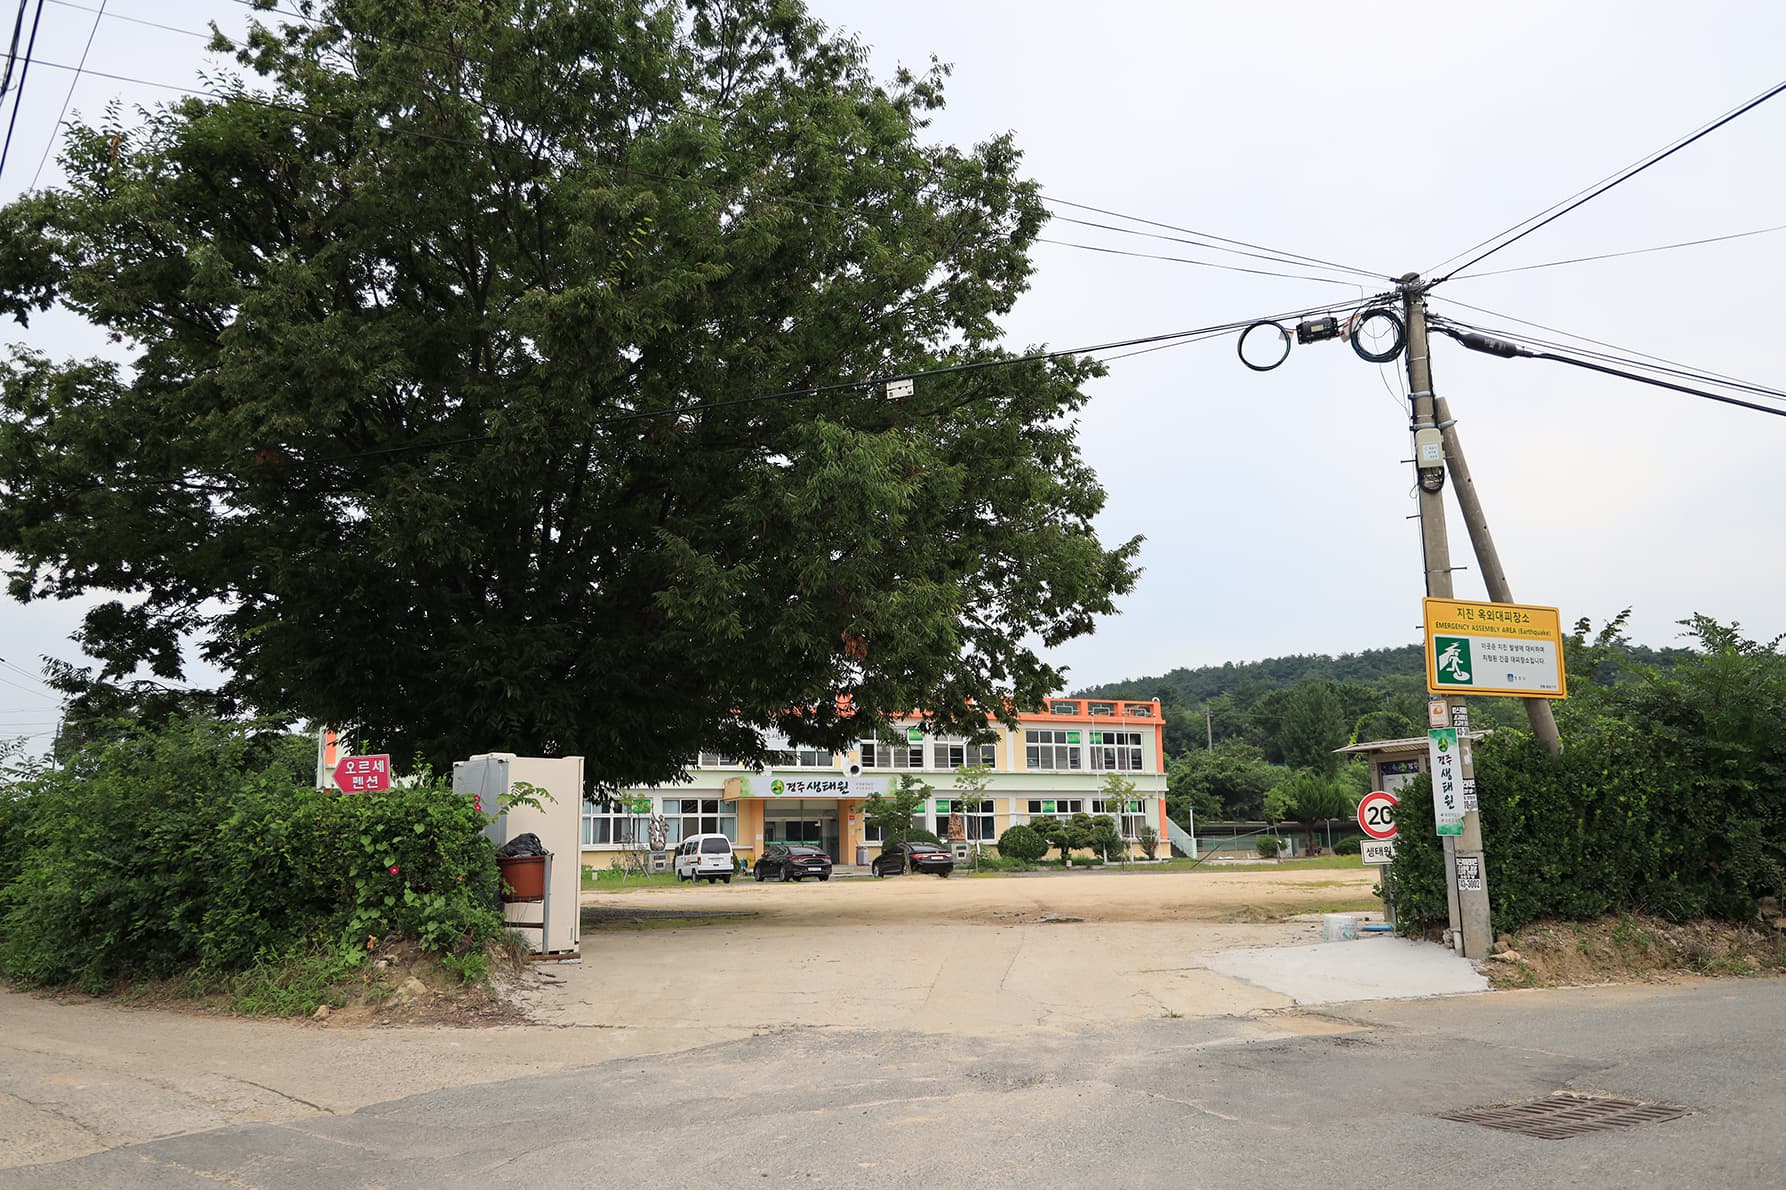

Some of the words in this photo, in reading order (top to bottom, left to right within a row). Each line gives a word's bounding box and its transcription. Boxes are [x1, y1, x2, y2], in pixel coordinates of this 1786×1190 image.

[1457, 607, 1474, 620] 지진
[1478, 608, 1530, 623] 옥외대피장소
[1435, 621, 1470, 631] EMERGENCY
[1471, 624, 1500, 633] ASSEMBLY
[345, 760, 384, 774] 오르세
[1437, 754, 1452, 766] 경주
[786, 781, 805, 793] 경주
[806, 781, 850, 795] 생태원
[1440, 767, 1455, 810] 생태원
[1367, 805, 1393, 825] 20
[1366, 846, 1393, 859] 생태원
